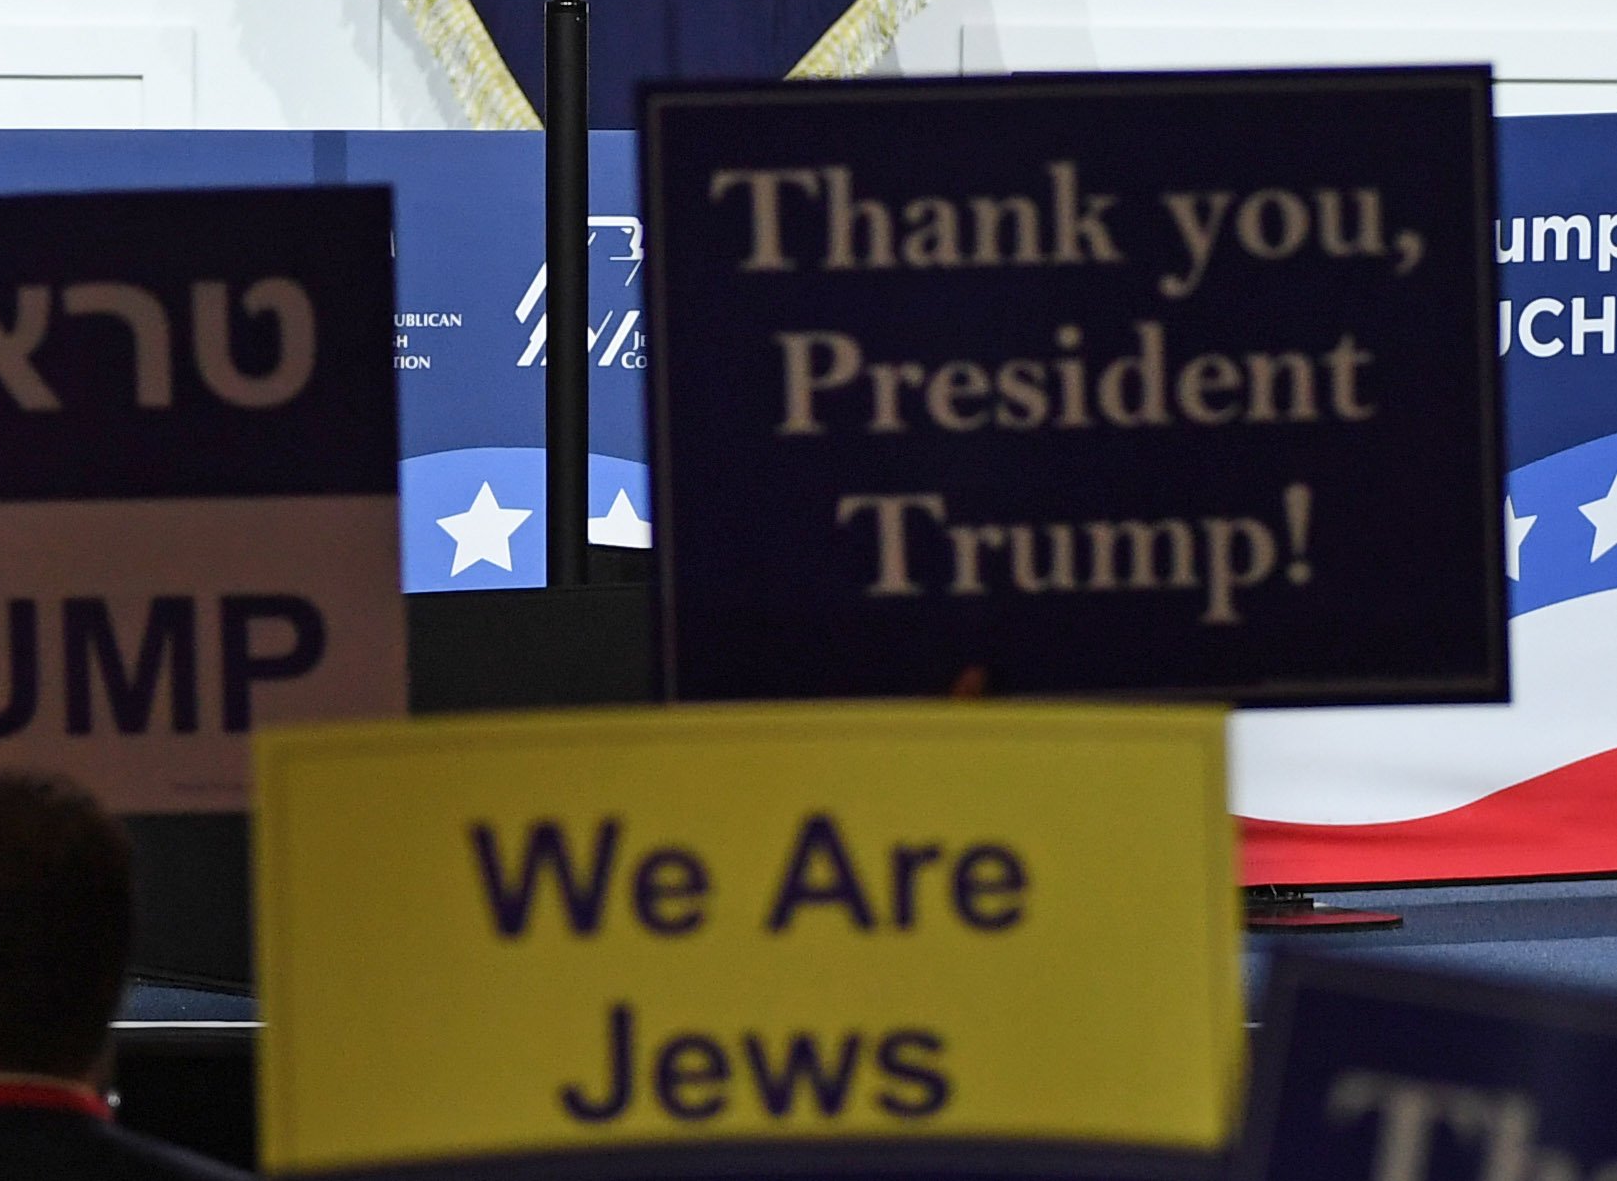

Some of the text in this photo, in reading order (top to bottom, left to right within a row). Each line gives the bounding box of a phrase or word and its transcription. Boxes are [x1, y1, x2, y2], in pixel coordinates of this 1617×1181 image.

[708, 162, 1427, 299] Thank you,
[394, 313, 462, 327] UBLICAN
[775, 321, 1377, 436] President
[836, 483, 1314, 625] Trump!
[468, 811, 1029, 941] We Are
[557, 1000, 954, 1124] Jews
